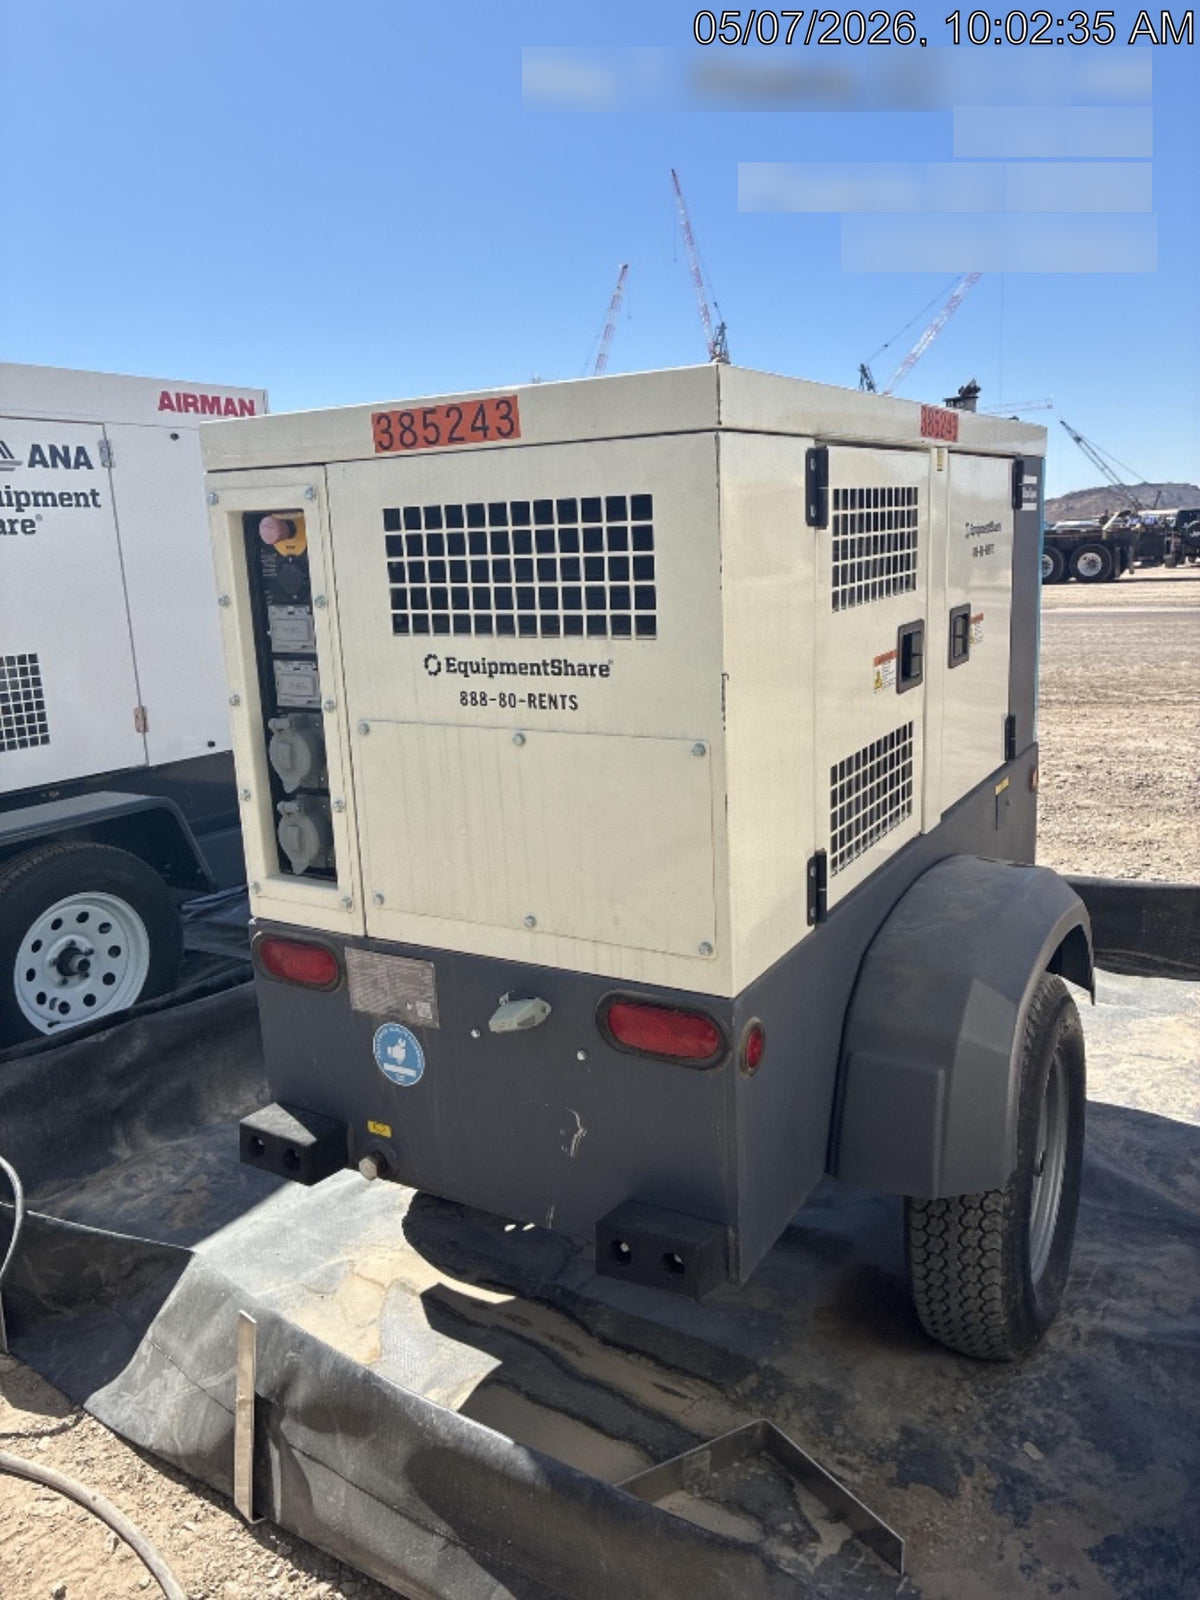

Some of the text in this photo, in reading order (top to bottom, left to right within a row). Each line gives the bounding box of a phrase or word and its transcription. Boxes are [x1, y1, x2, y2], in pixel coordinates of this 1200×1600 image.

[158, 390, 255, 416] AIRMAN
[376, 400, 514, 450] 385243
[28, 444, 94, 469] ANA
[445, 657, 611, 678] EquipmentShare
[459, 691, 578, 710] 888-80-RENTS
